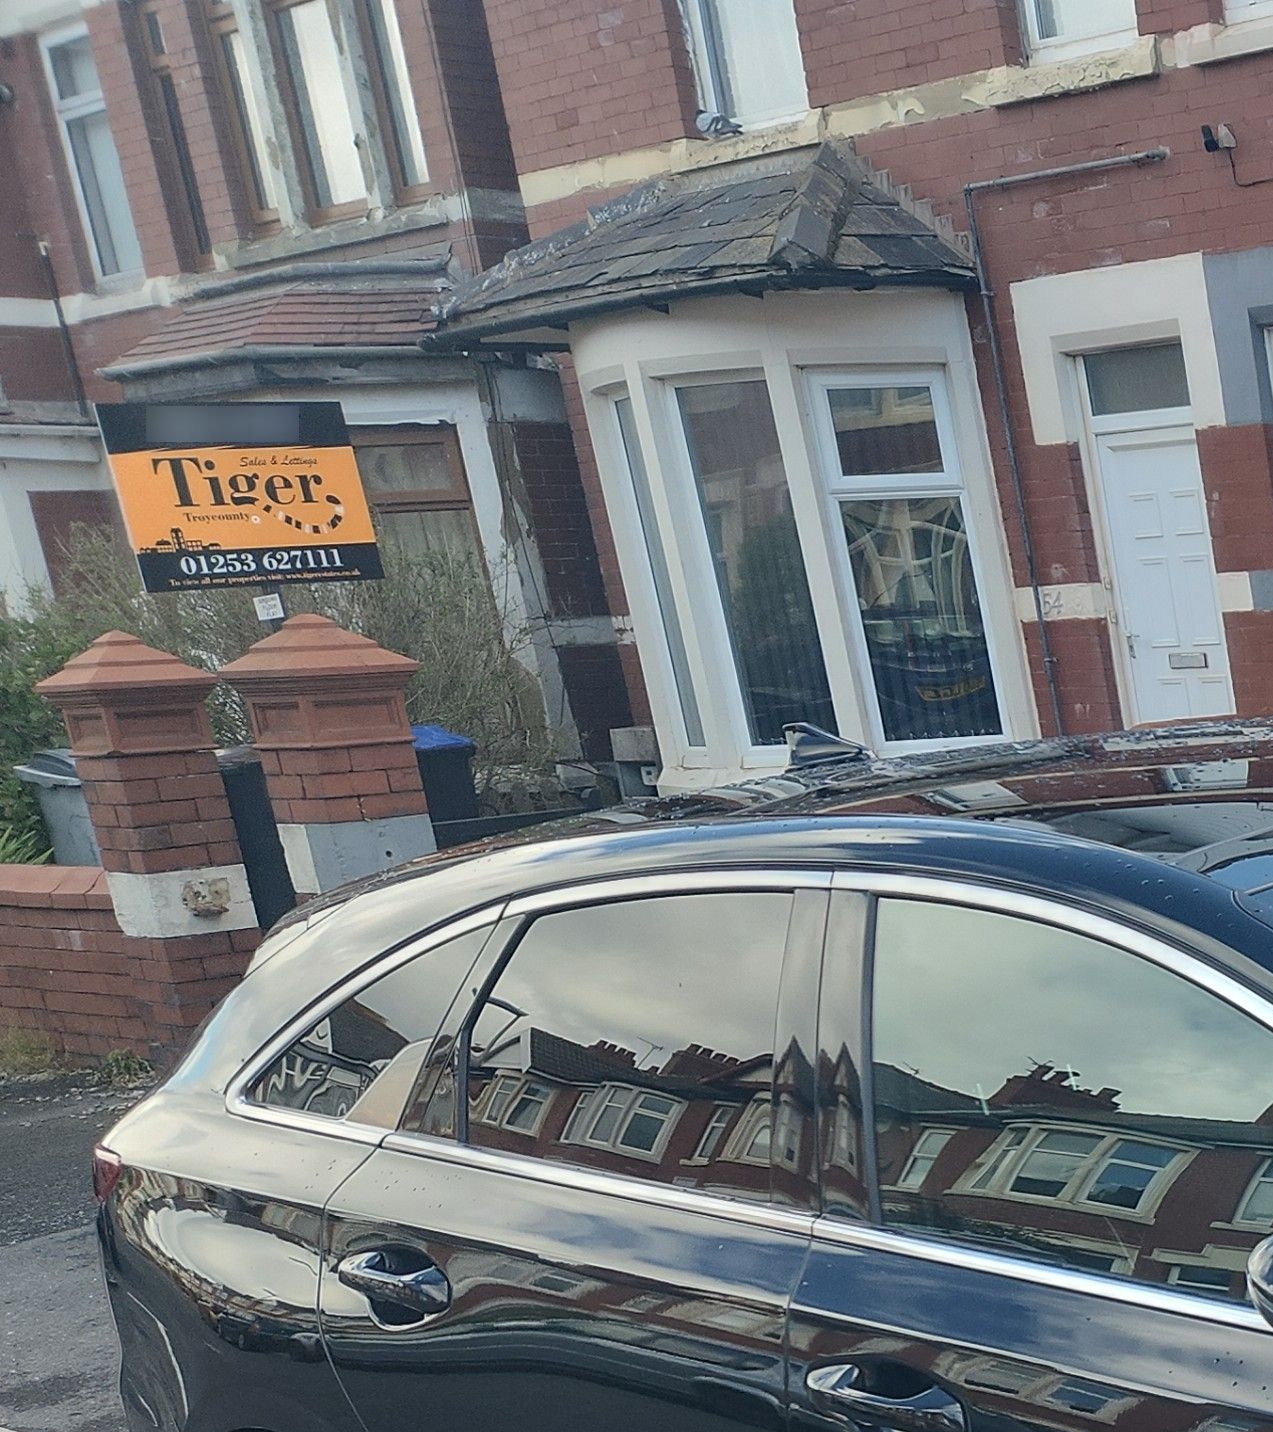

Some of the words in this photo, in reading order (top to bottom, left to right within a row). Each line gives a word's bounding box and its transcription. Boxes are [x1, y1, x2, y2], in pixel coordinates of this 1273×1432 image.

[240, 456, 267, 467] Sales
[270, 455, 278, 465] &
[281, 455, 318, 468] Lettings
[152, 457, 323, 507] Tiger
[180, 552, 257, 576] 01253
[262, 549, 344, 570] 627111
[1042, 590, 1063, 615] 54
